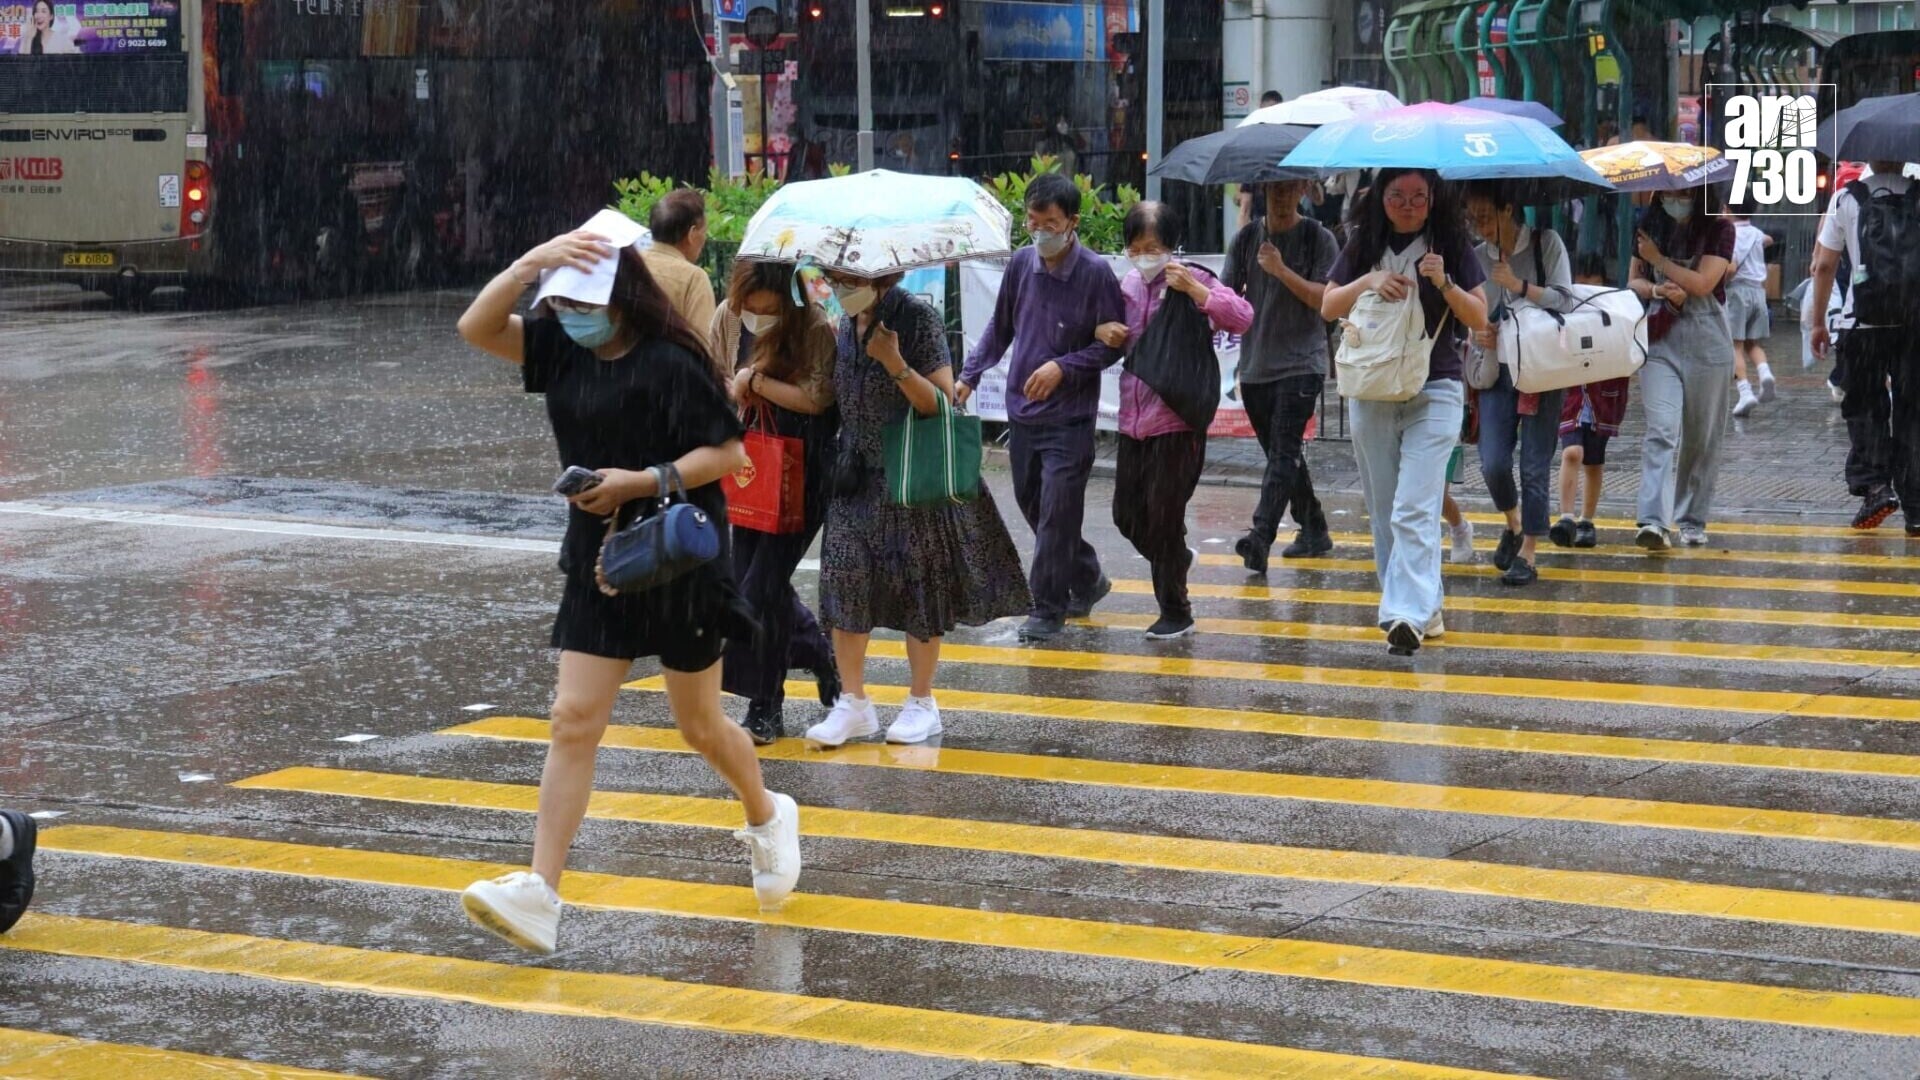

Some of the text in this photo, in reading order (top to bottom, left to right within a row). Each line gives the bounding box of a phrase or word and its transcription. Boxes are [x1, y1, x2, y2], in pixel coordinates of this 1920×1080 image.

[127, 39, 147, 47] 9022
[32, 128, 106, 141] ENVIRO
[14, 157, 64, 180] KMB
